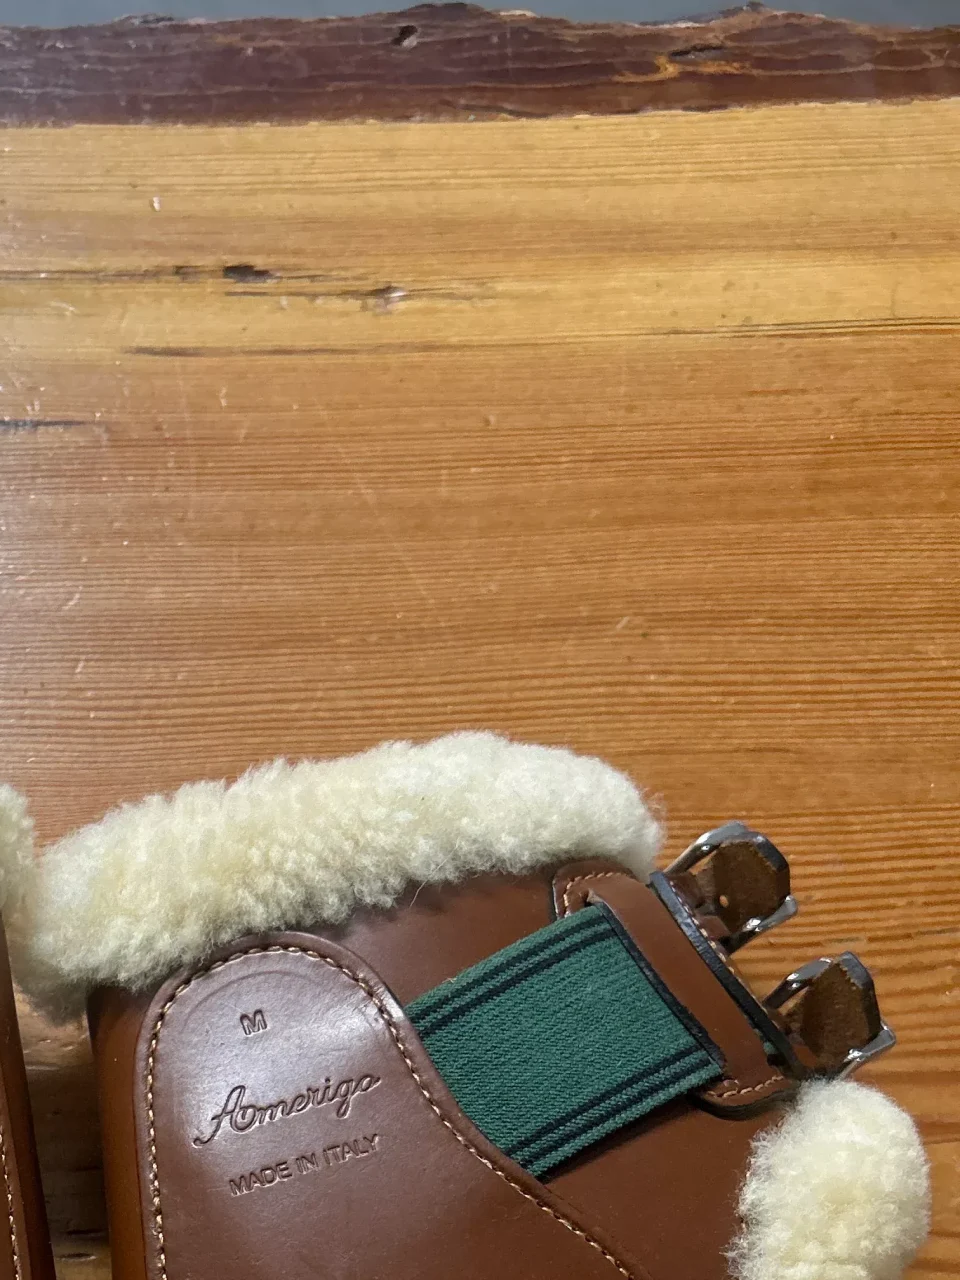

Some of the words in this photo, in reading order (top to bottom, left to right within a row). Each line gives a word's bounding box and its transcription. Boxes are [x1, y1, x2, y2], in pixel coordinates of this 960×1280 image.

[240, 1009, 268, 1036] M
[191, 1074, 381, 1148] Amerigo
[229, 1162, 292, 1196] MADE
[296, 1152, 319, 1174] IN
[322, 1133, 380, 1167] ITALY
